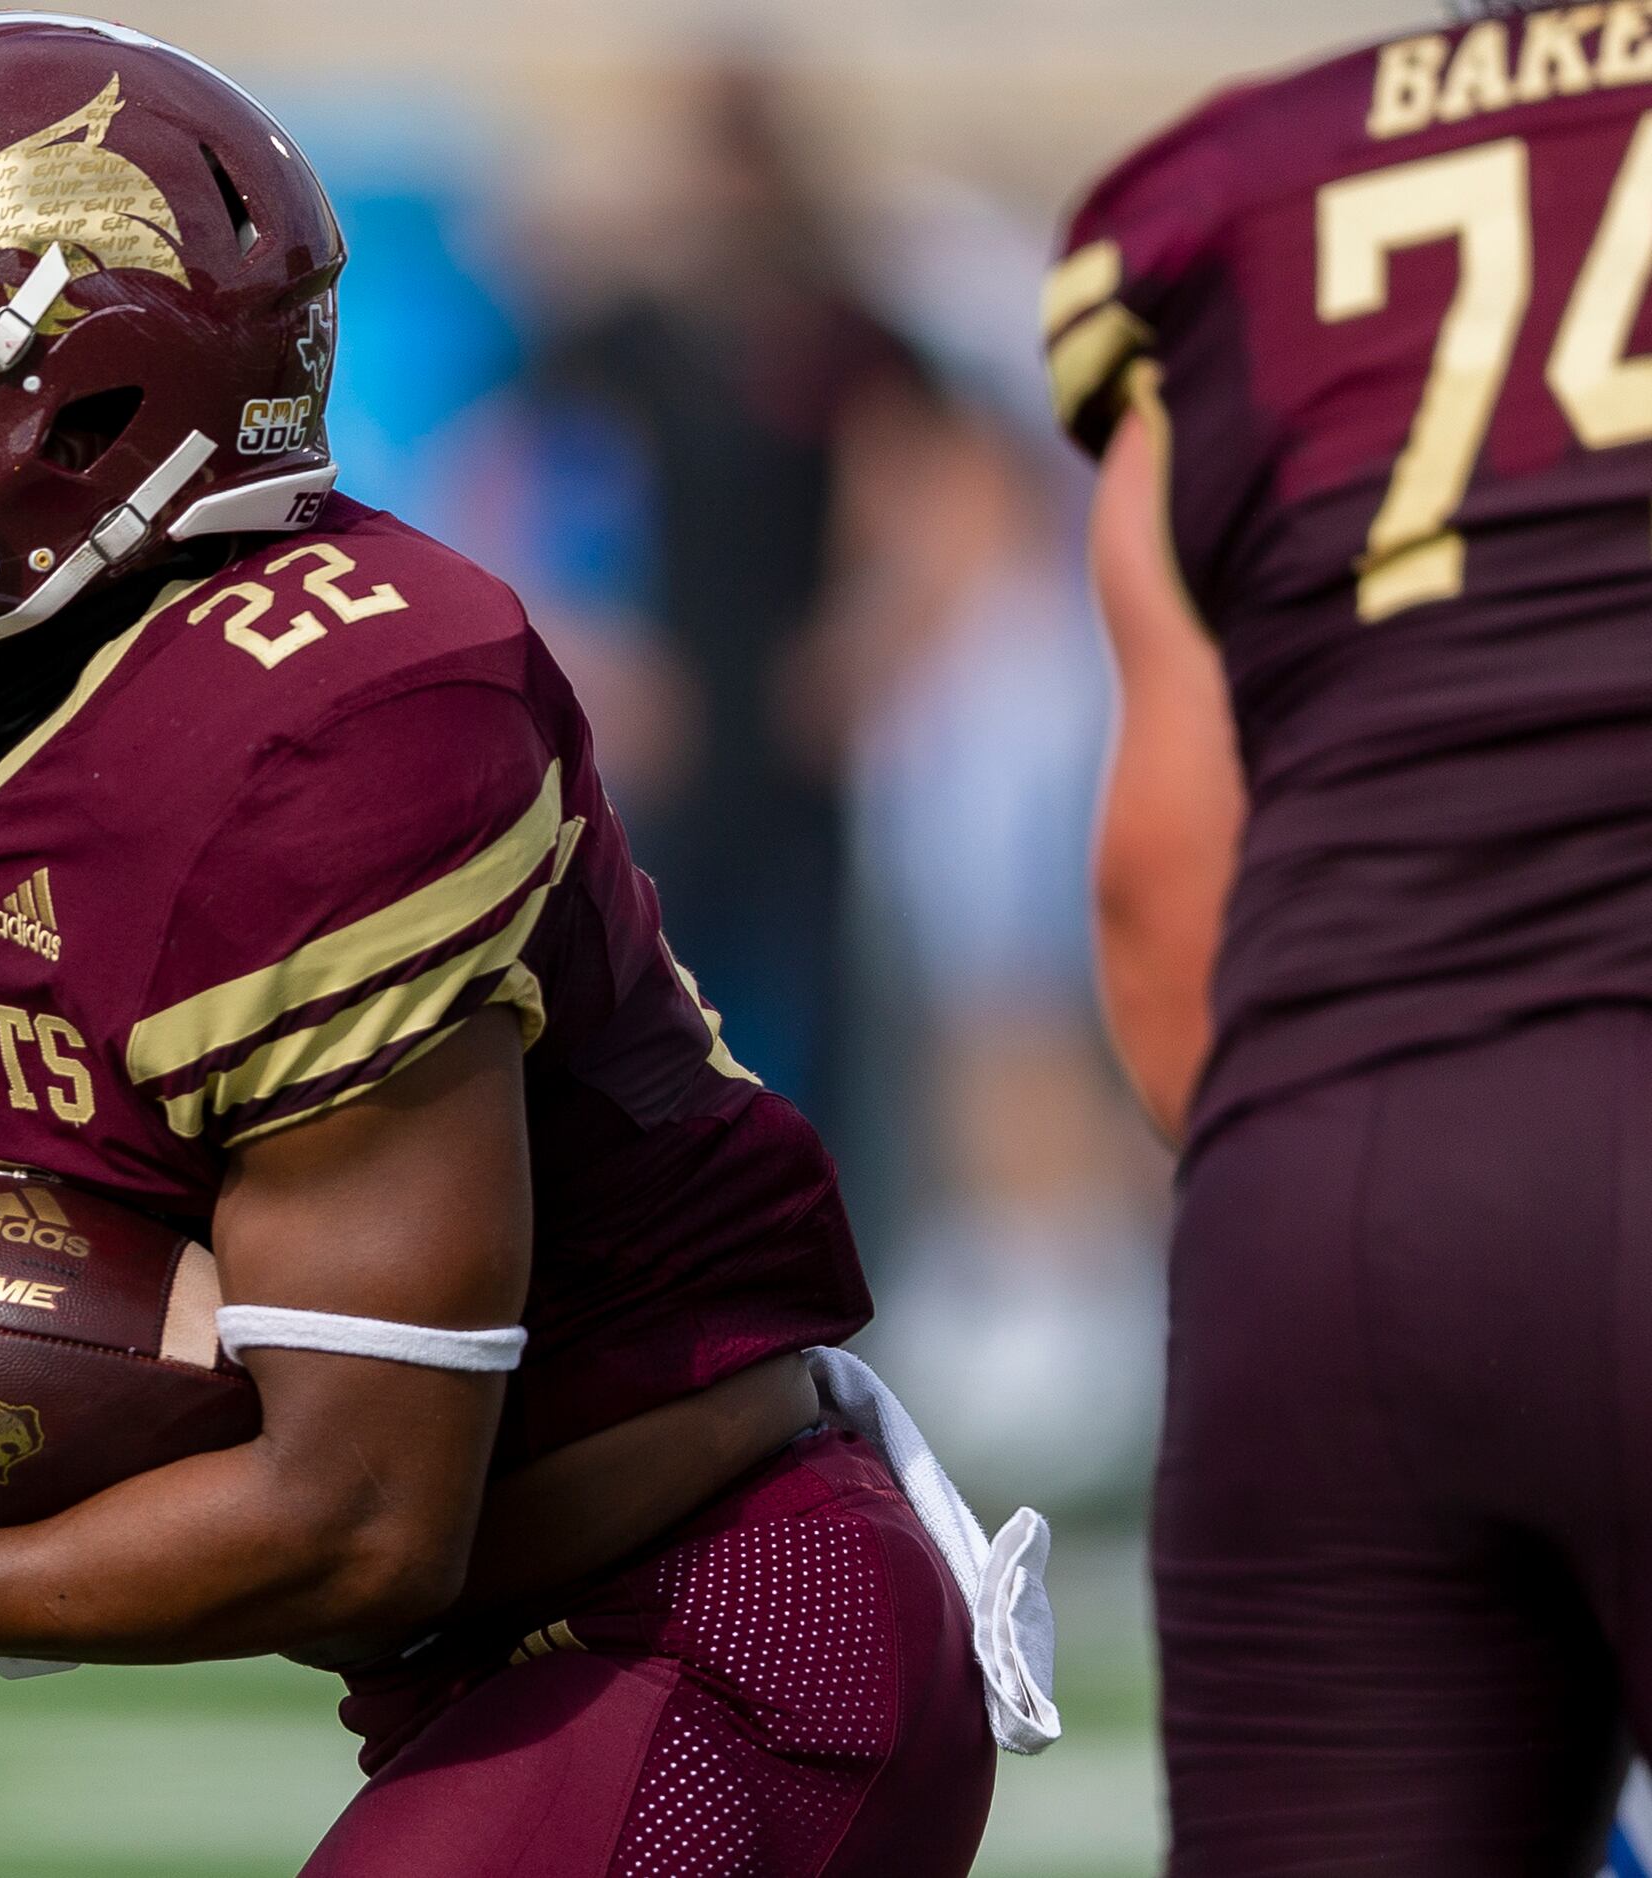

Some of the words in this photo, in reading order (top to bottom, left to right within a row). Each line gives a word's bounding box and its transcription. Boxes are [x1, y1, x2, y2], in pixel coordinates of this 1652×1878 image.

[33, 161, 72, 177] EAT
[97, 178, 134, 193] EAT
[1, 203, 23, 220] UP
[37, 199, 76, 216] EAT
[113, 196, 136, 212] UP
[64, 218, 87, 234] UP
[117, 235, 140, 251] UP
[237, 396, 312, 455] SBC
[186, 542, 410, 670] 22
